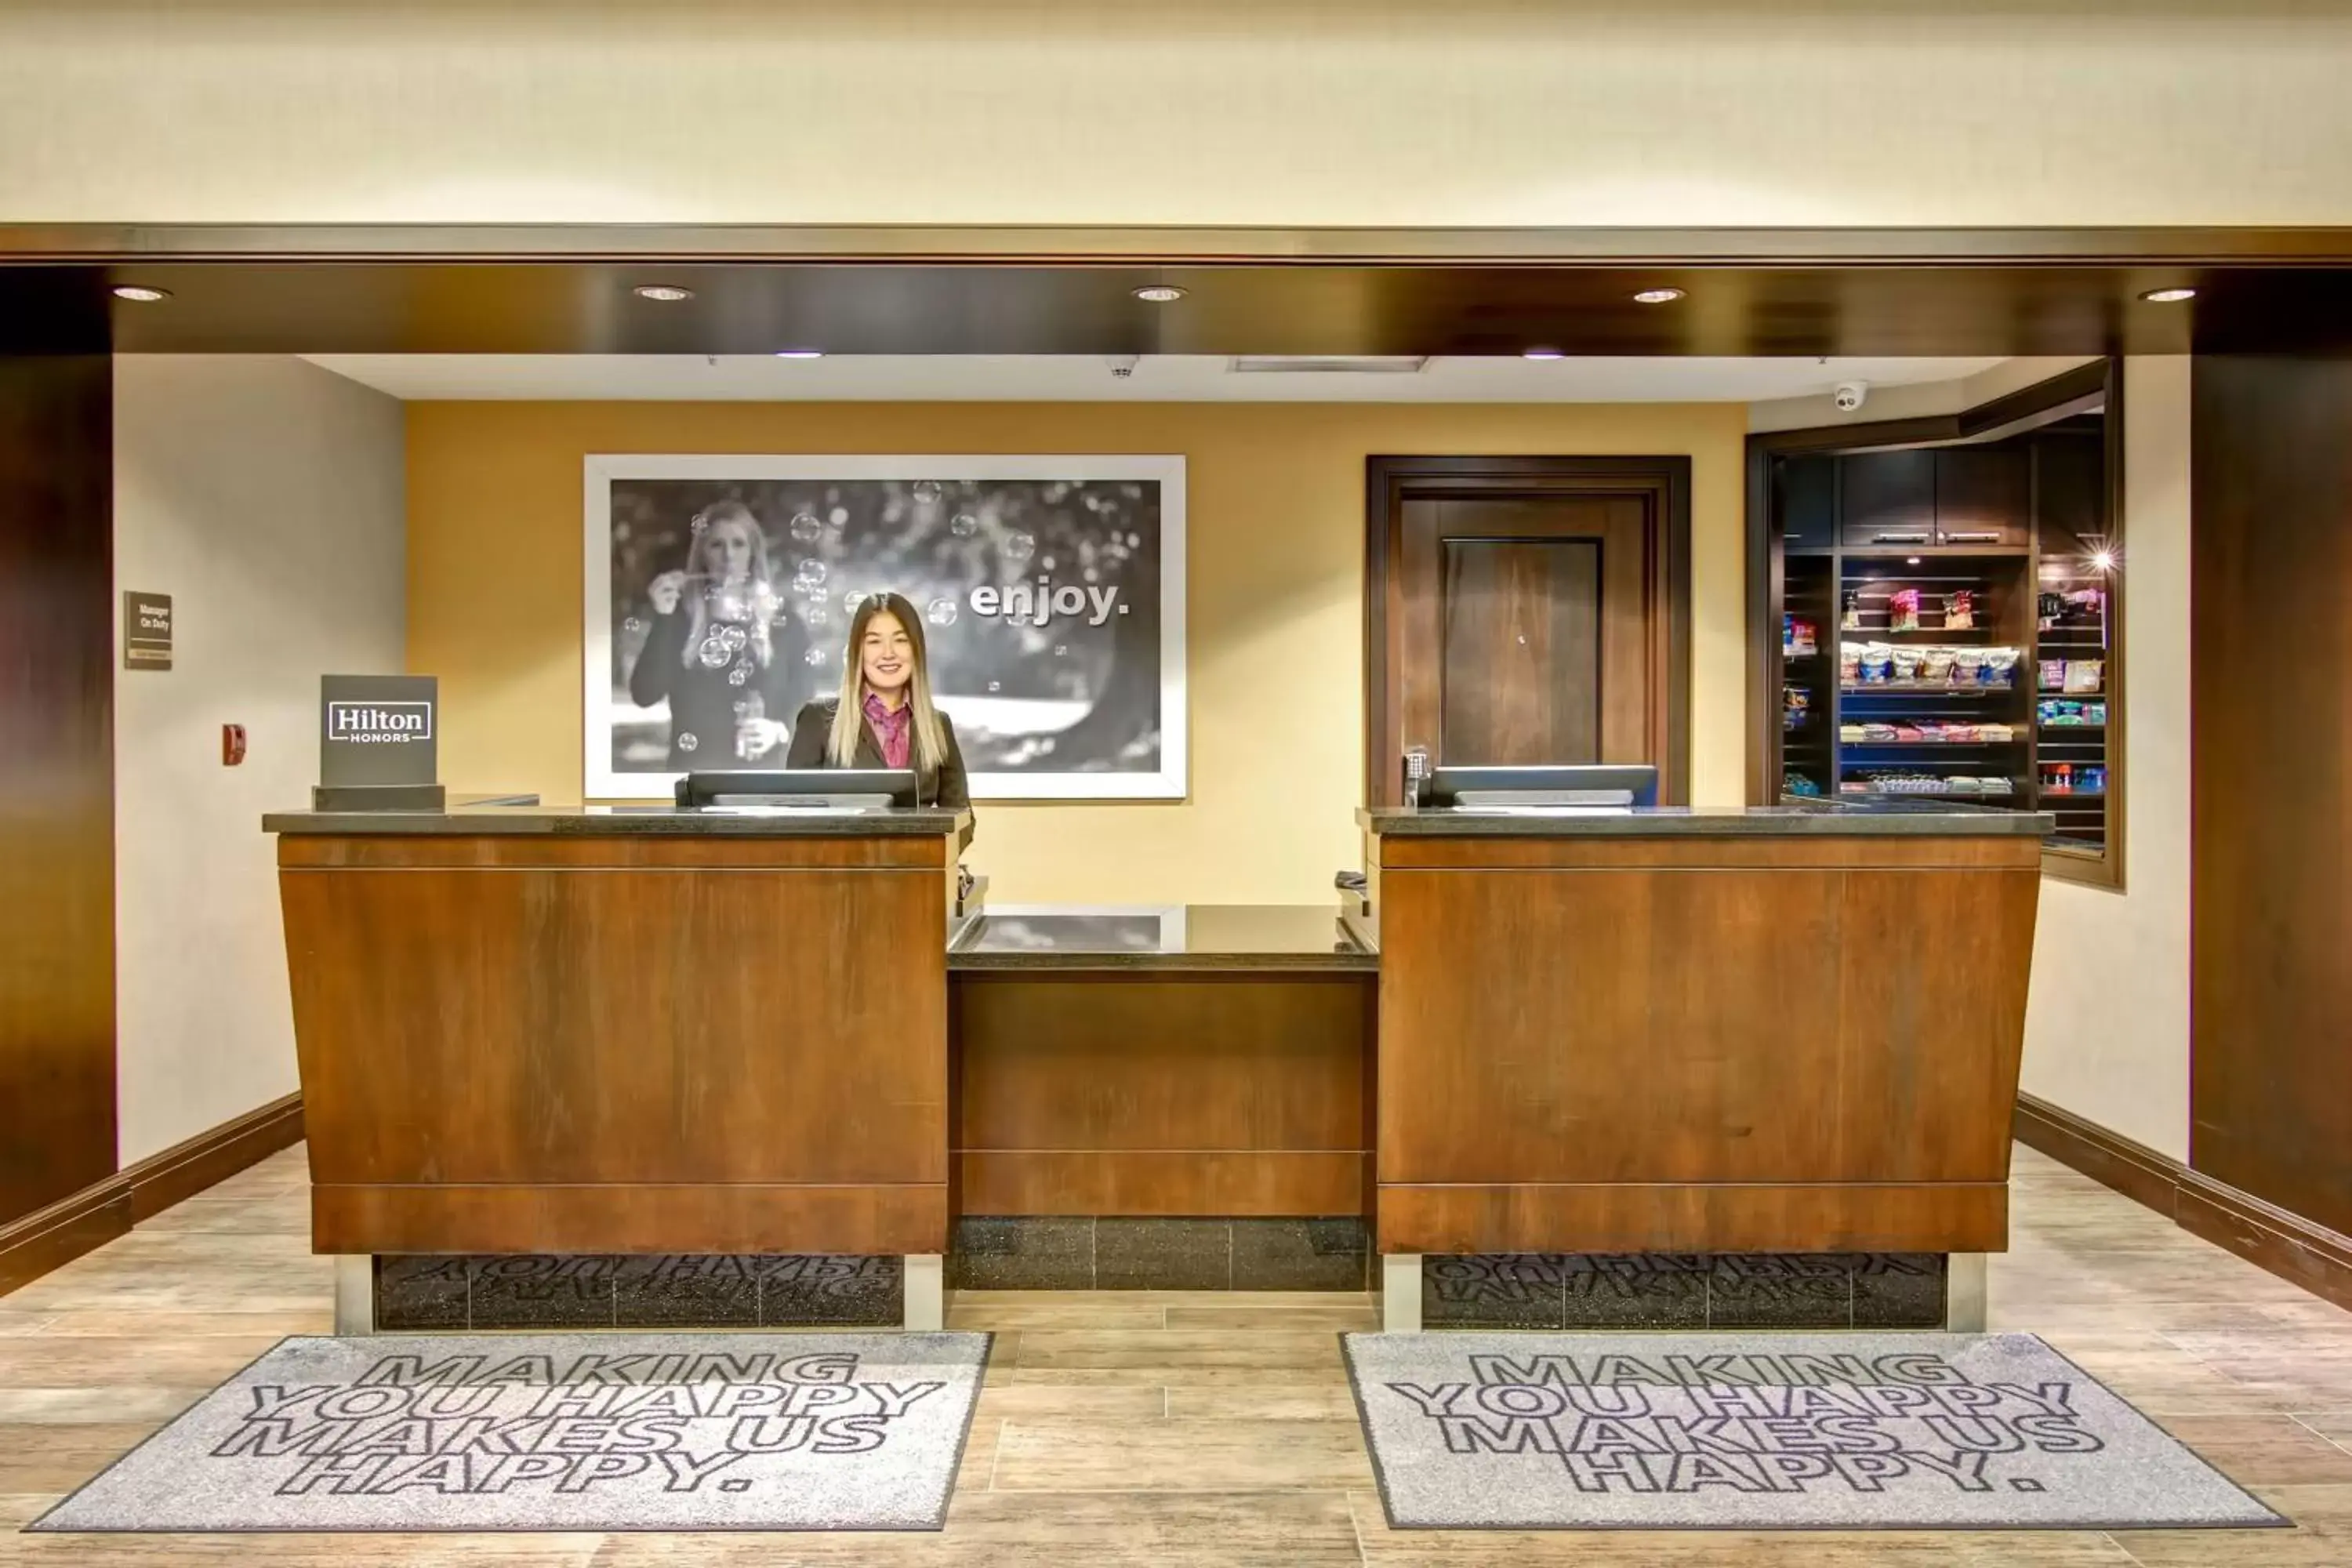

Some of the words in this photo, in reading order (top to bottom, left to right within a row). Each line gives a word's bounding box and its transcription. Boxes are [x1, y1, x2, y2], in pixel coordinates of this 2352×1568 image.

[970, 575, 1129, 626] enjoy.
[141, 617, 151, 628] On
[153, 618, 169, 633] Duty
[337, 709, 422, 730] Hilton
[350, 733, 410, 742] HONORS
[352, 1353, 861, 1386] MAKING
[1468, 1354, 1972, 1386] MAKING
[243, 1385, 507, 1420] YOU
[526, 1382, 947, 1417] HAPPY
[1385, 1383, 1652, 1417] YOU
[1683, 1383, 2080, 1417] HAPPY
[209, 1415, 691, 1457] MAKES
[725, 1414, 888, 1454] US
[1437, 1415, 1903, 1454] MAKES
[1921, 1414, 2105, 1453] US
[274, 1451, 753, 1494] HAPPY.
[1562, 1451, 2046, 1492] HAPPY.
